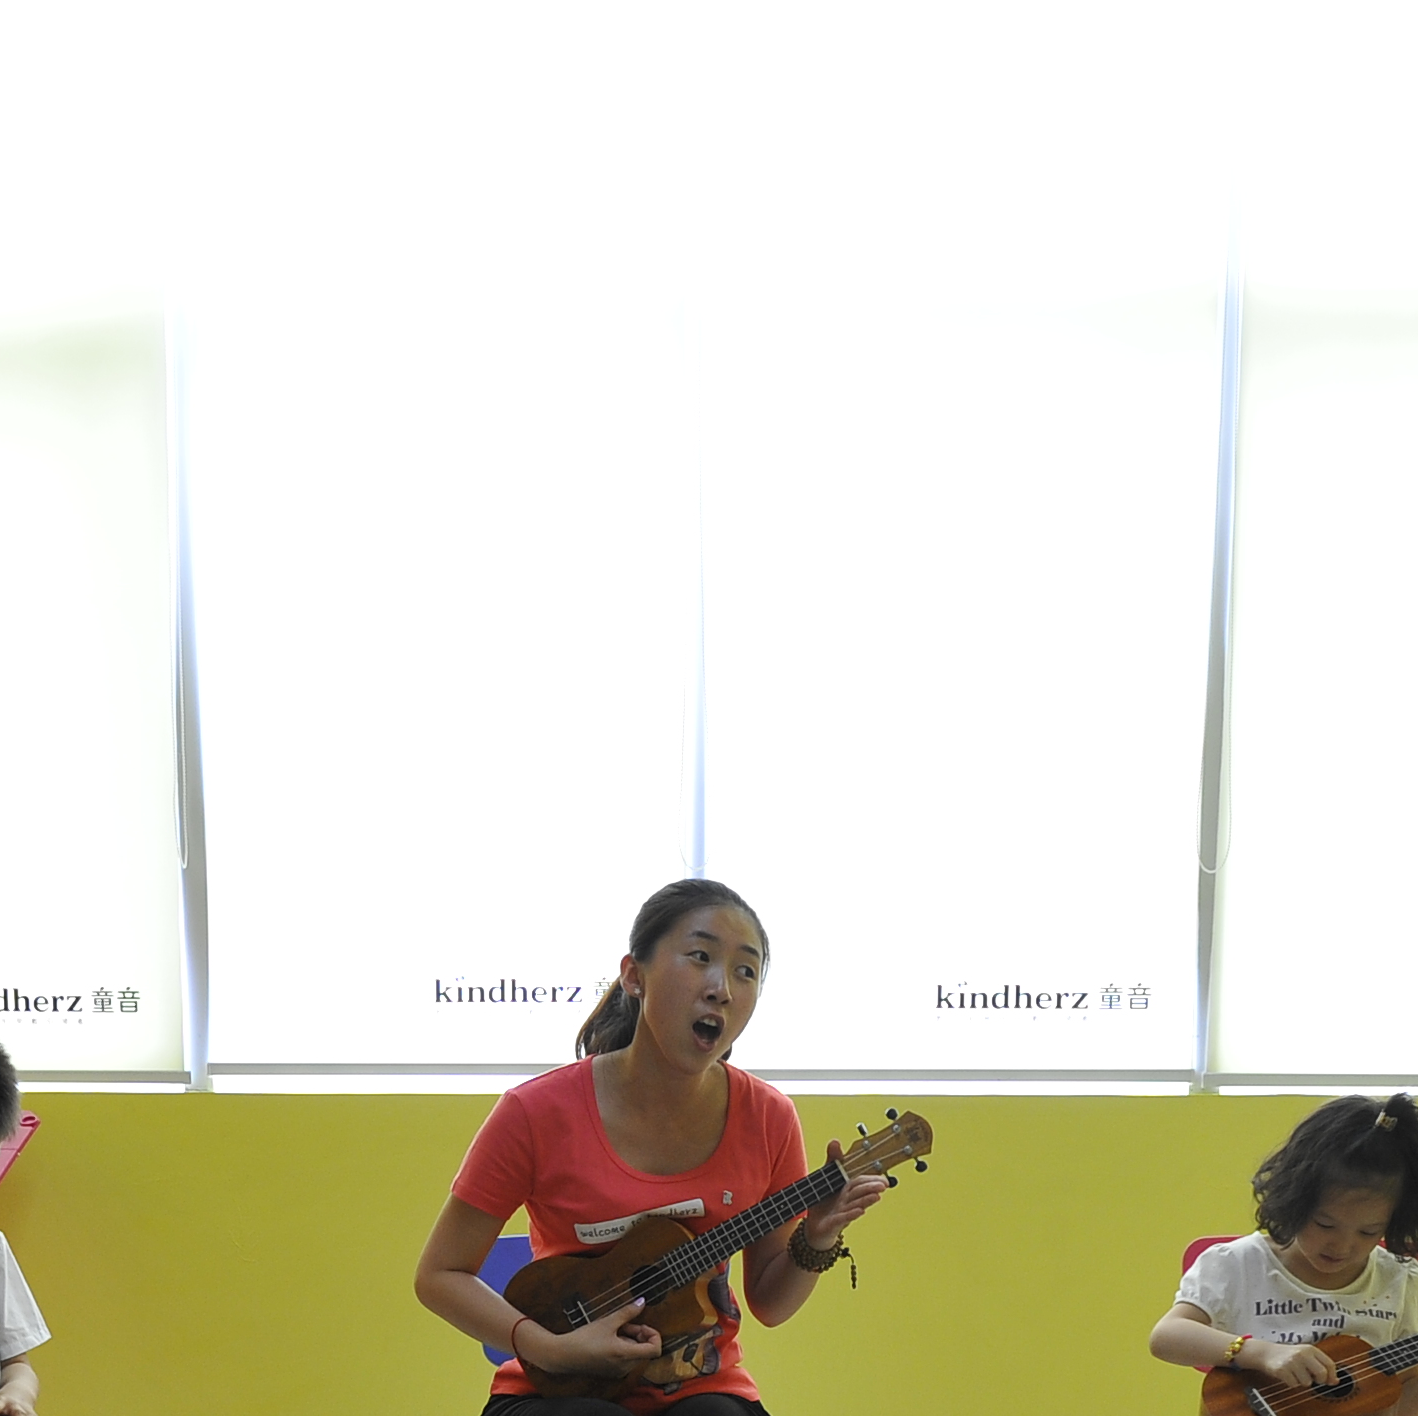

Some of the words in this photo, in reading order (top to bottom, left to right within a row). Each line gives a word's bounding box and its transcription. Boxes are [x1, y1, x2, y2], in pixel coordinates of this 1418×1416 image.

[92, 987, 140, 1012] 童音
[1101, 983, 1151, 1009] 童音
[1254, 1298, 1303, 1317] Little
[1311, 1314, 1346, 1329] and
